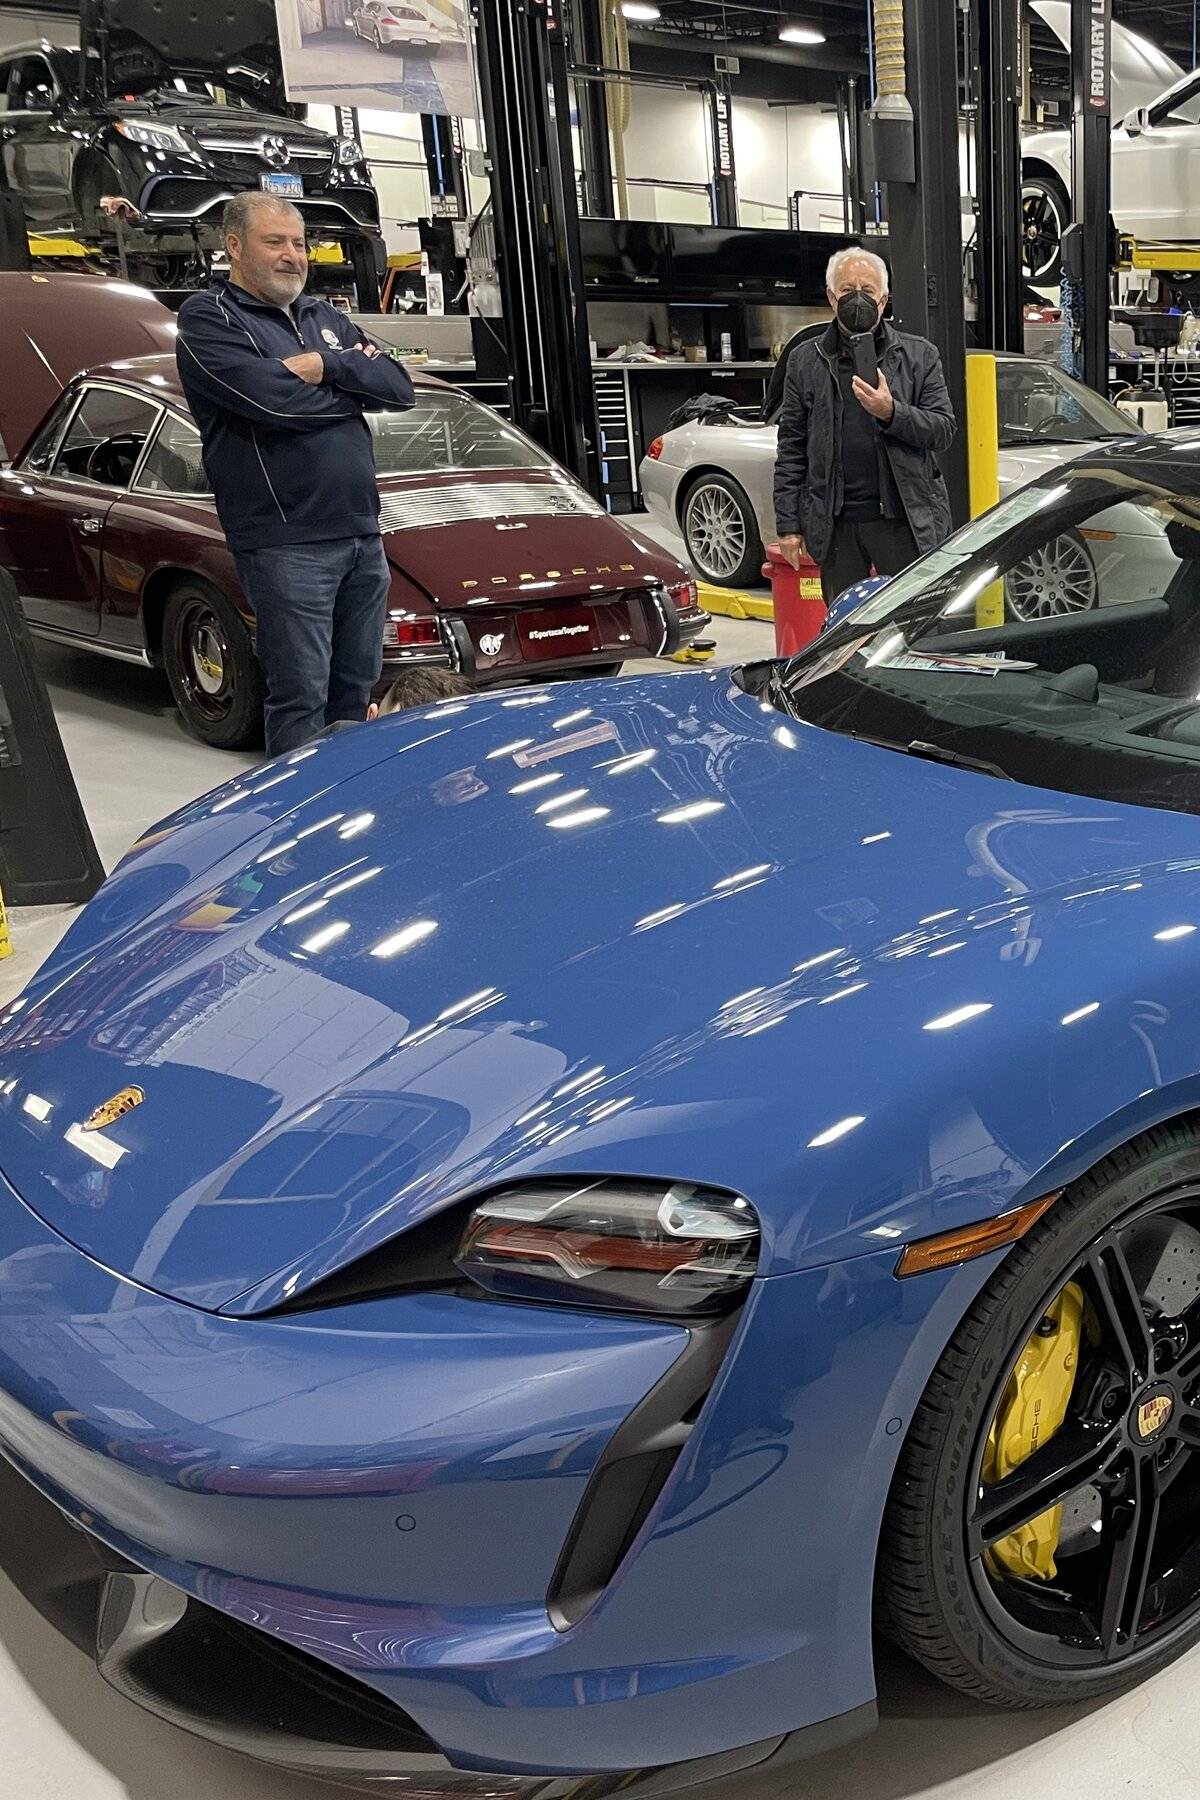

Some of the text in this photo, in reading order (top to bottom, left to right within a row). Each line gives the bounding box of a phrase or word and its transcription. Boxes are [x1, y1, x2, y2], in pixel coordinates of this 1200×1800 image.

[1091, 19, 1104, 96] ROTARY
[716, 93, 731, 169] ROTARY LIFT
[461, 563, 636, 589] PORSCHE
